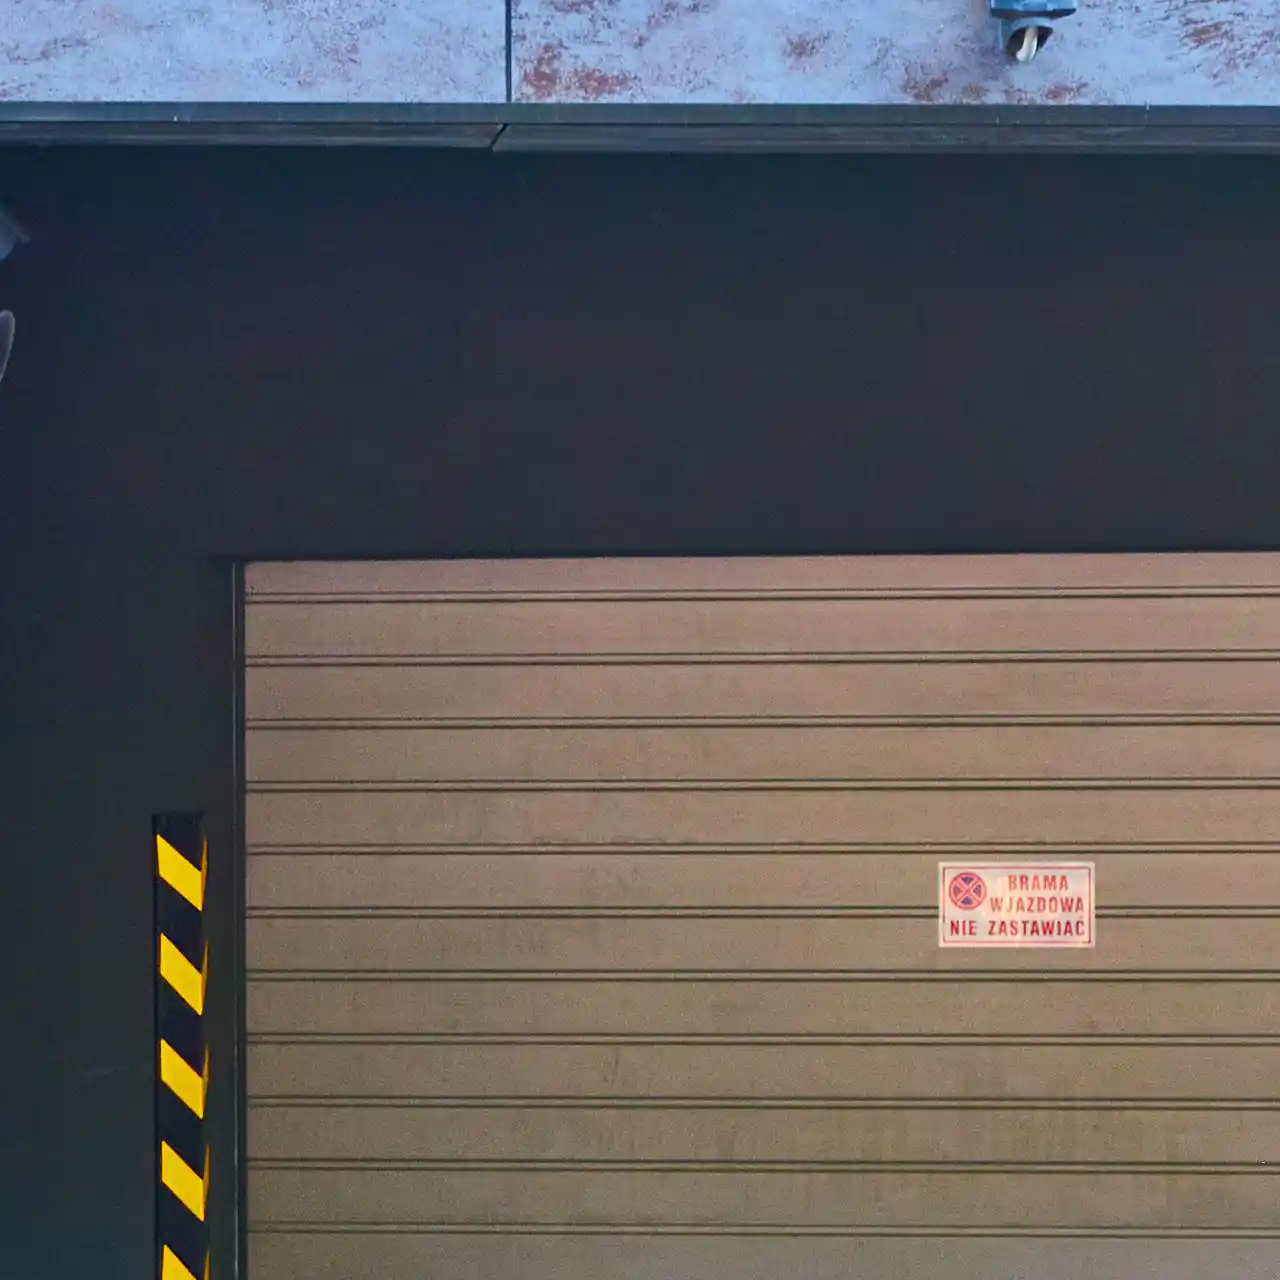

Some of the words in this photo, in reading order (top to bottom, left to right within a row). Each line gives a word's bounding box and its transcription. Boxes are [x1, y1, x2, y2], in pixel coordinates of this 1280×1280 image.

[1008, 875, 1069, 890] BRAMA
[990, 897, 1084, 913] WJAZDOWA
[950, 920, 977, 936] NIE
